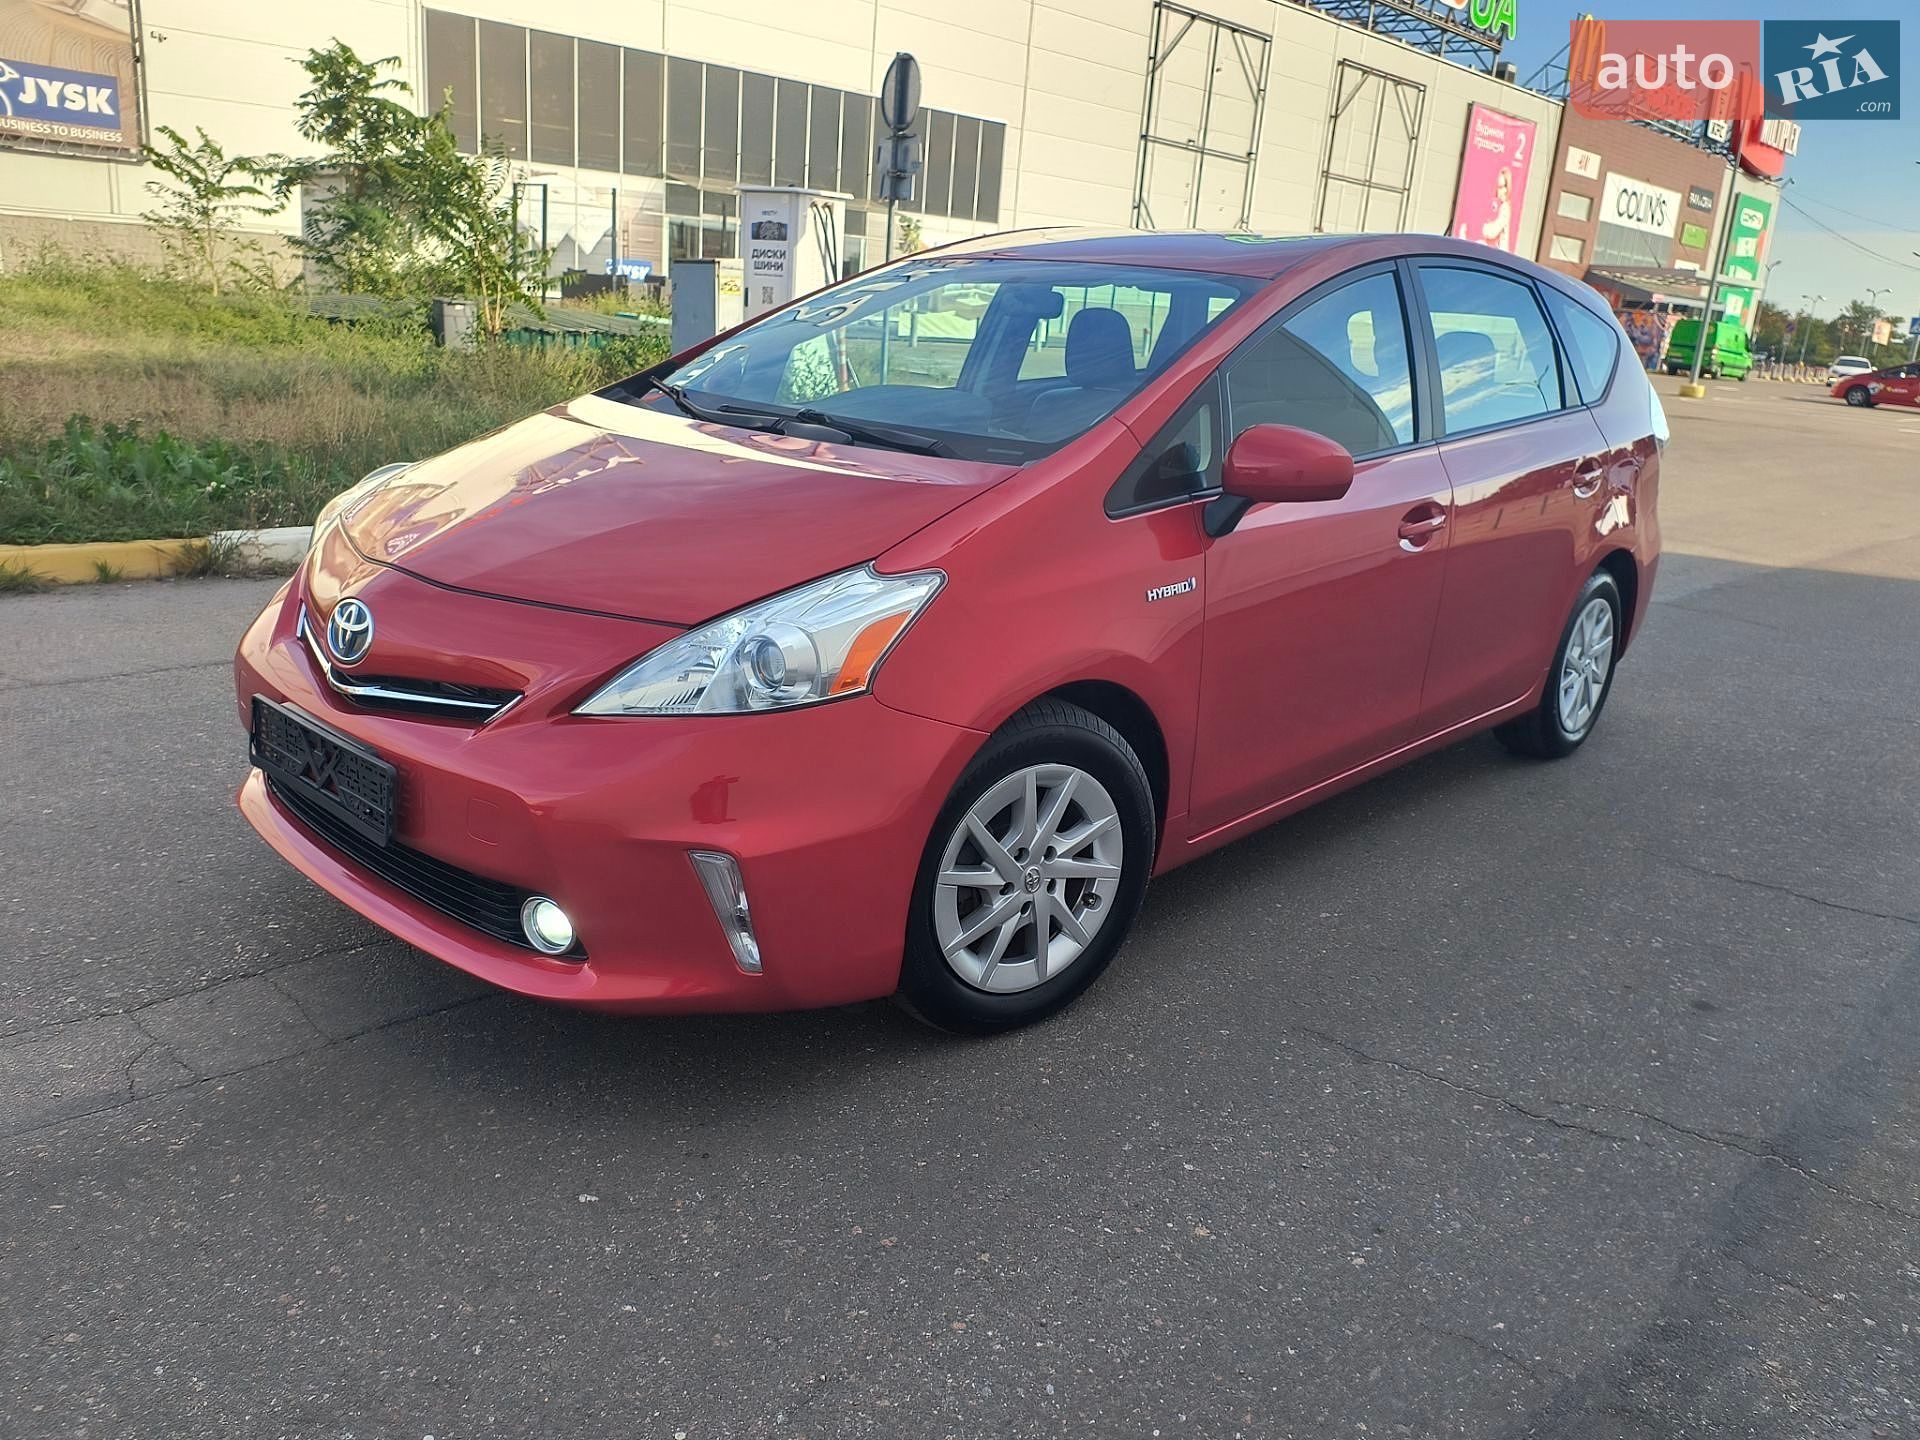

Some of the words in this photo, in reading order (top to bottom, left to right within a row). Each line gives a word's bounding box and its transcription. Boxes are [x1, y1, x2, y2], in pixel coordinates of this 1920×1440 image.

[18, 76, 115, 116] JYSK
[52, 124, 69, 136] TO
[70, 127, 123, 143] BUSINESS
[1514, 131, 1527, 160] 2
[1616, 187, 1668, 228] COLIN'S
[751, 248, 787, 260] ДИСКИ
[753, 260, 784, 272] ШИНИ
[1147, 580, 1190, 602] HYBRID
